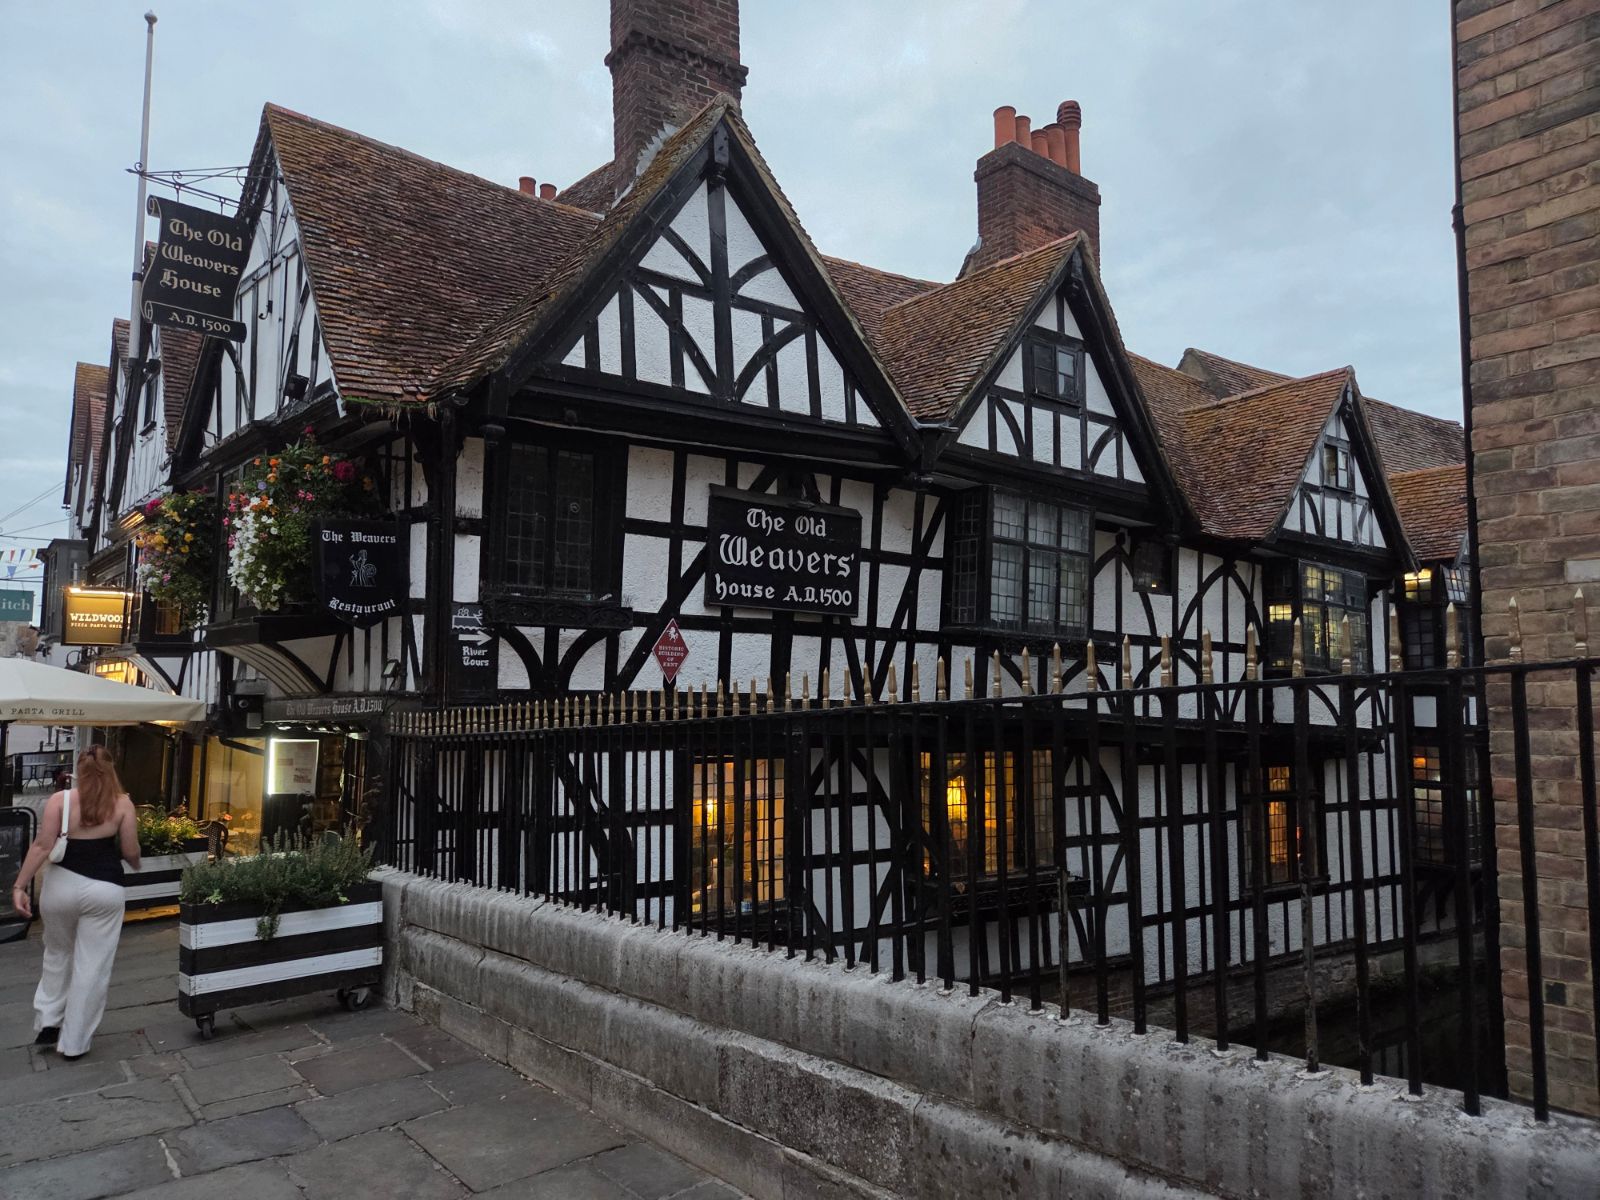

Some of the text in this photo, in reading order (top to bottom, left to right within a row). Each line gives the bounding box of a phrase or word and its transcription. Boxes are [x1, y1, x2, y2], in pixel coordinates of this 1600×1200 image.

[169, 218, 243, 251] The Old
[161, 241, 239, 276] Weavers
[160, 268, 222, 298] House
[202, 318, 231, 333] 1500
[747, 508, 827, 538] The Old
[321, 529, 396, 544] The Weavers
[719, 533, 855, 578] Weavers'
[328, 597, 396, 614] Restaurant
[462, 646, 488, 657] River
[462, 657, 490, 667] Tours
[52, 708, 85, 716] GRILL
